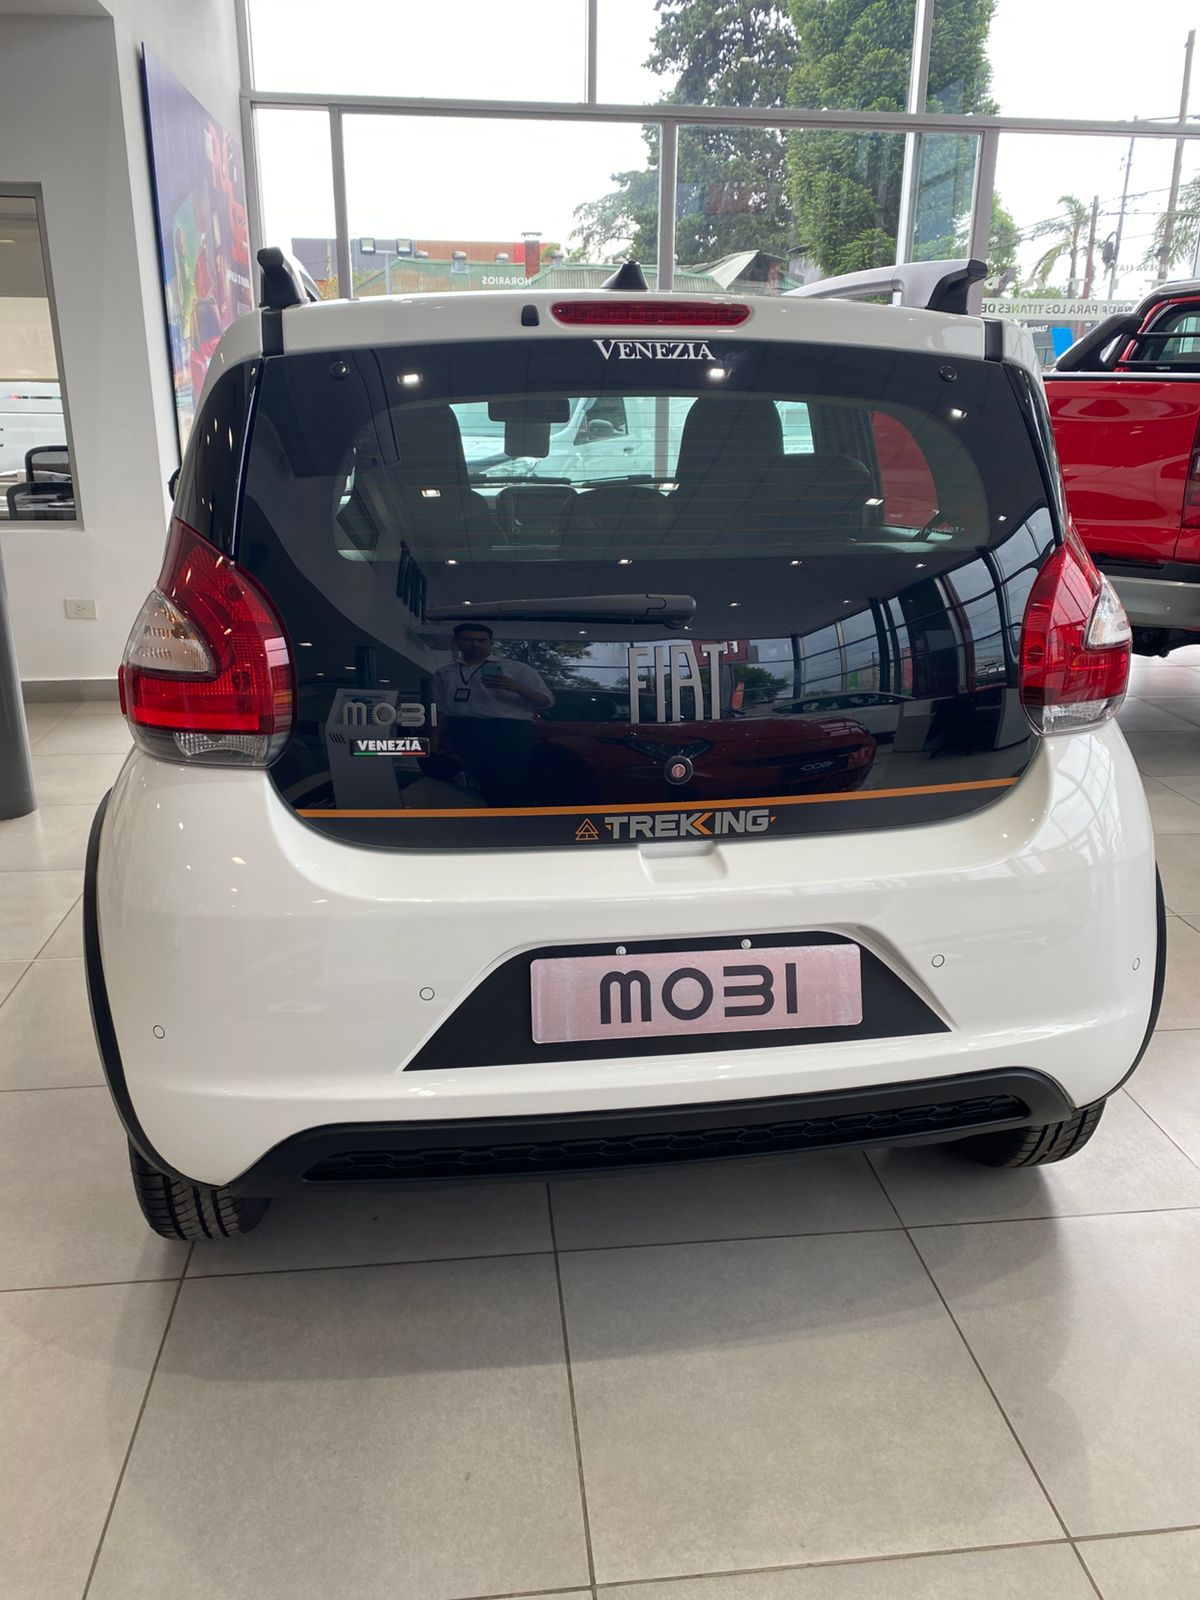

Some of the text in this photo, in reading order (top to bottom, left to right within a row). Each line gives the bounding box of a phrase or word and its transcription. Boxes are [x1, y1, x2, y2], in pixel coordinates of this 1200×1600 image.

[593, 339, 716, 361] VENEZIA
[628, 643, 725, 724] FIAT
[342, 701, 438, 727] MOBI
[357, 739, 422, 751] VENEZIA
[600, 962, 797, 1025] MOBI
